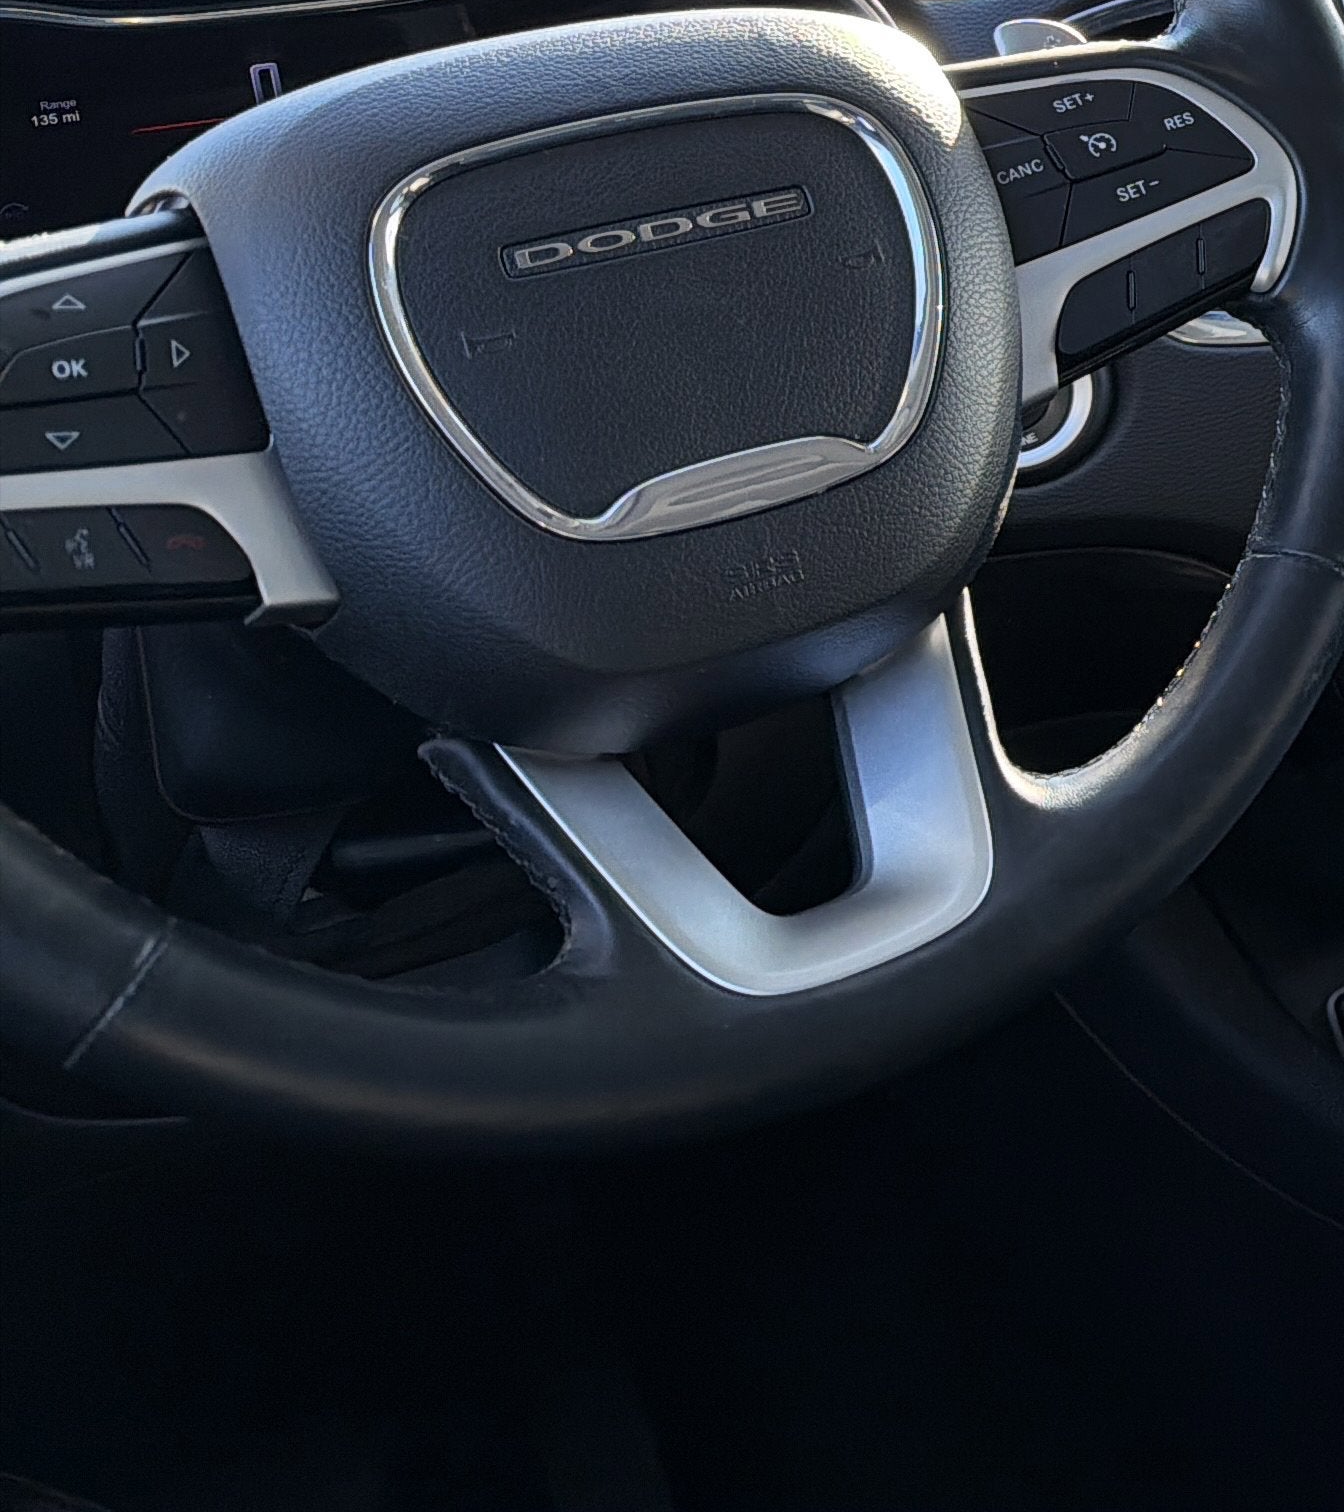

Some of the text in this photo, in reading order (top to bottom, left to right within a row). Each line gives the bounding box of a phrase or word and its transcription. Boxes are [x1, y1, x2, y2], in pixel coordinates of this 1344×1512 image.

[40, 98, 77, 111] Range
[1053, 91, 1095, 114] SET+
[31, 109, 81, 128] 135 mi
[1163, 110, 1195, 131] RES
[996, 158, 1045, 186] CANC
[514, 191, 802, 270] DODGE
[51, 359, 88, 379] OK
